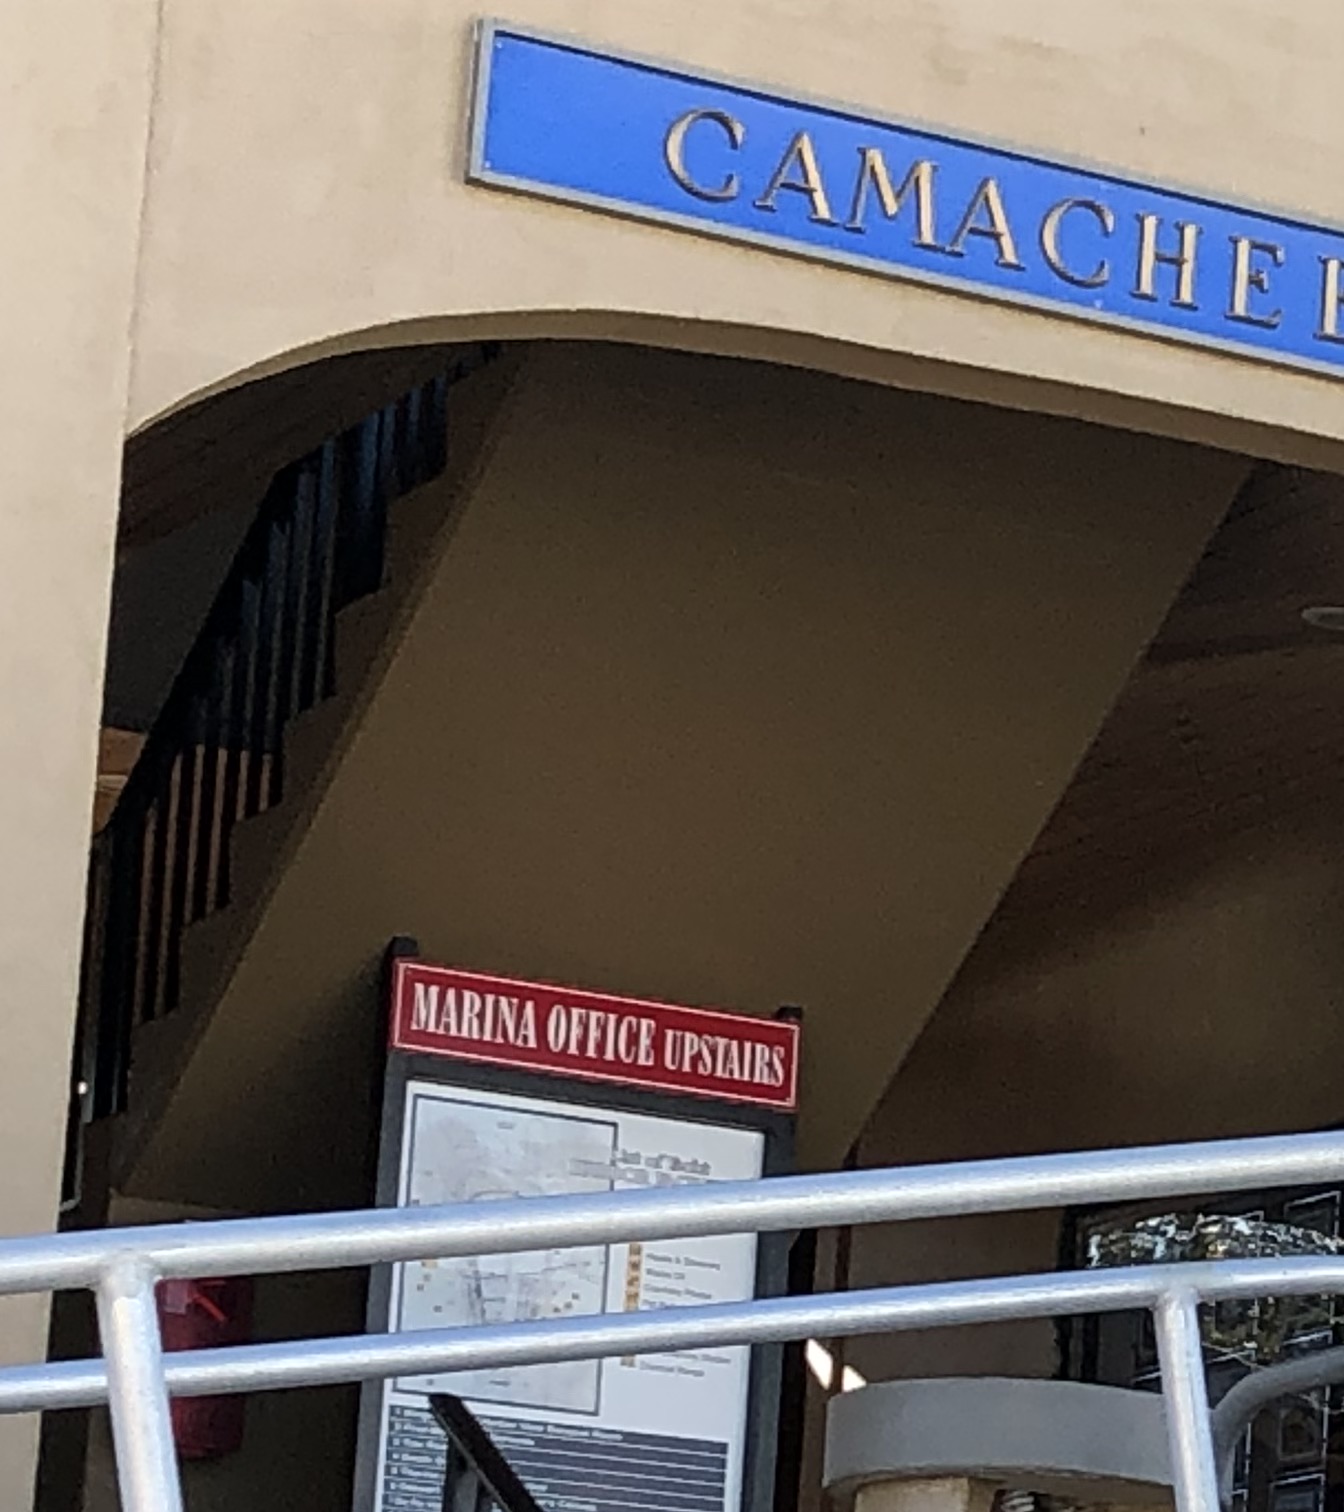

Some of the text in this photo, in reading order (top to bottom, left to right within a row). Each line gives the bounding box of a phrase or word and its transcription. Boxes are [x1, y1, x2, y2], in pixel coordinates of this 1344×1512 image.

[410, 981, 786, 1088] MARINA OFFICE UPSTAIRS
